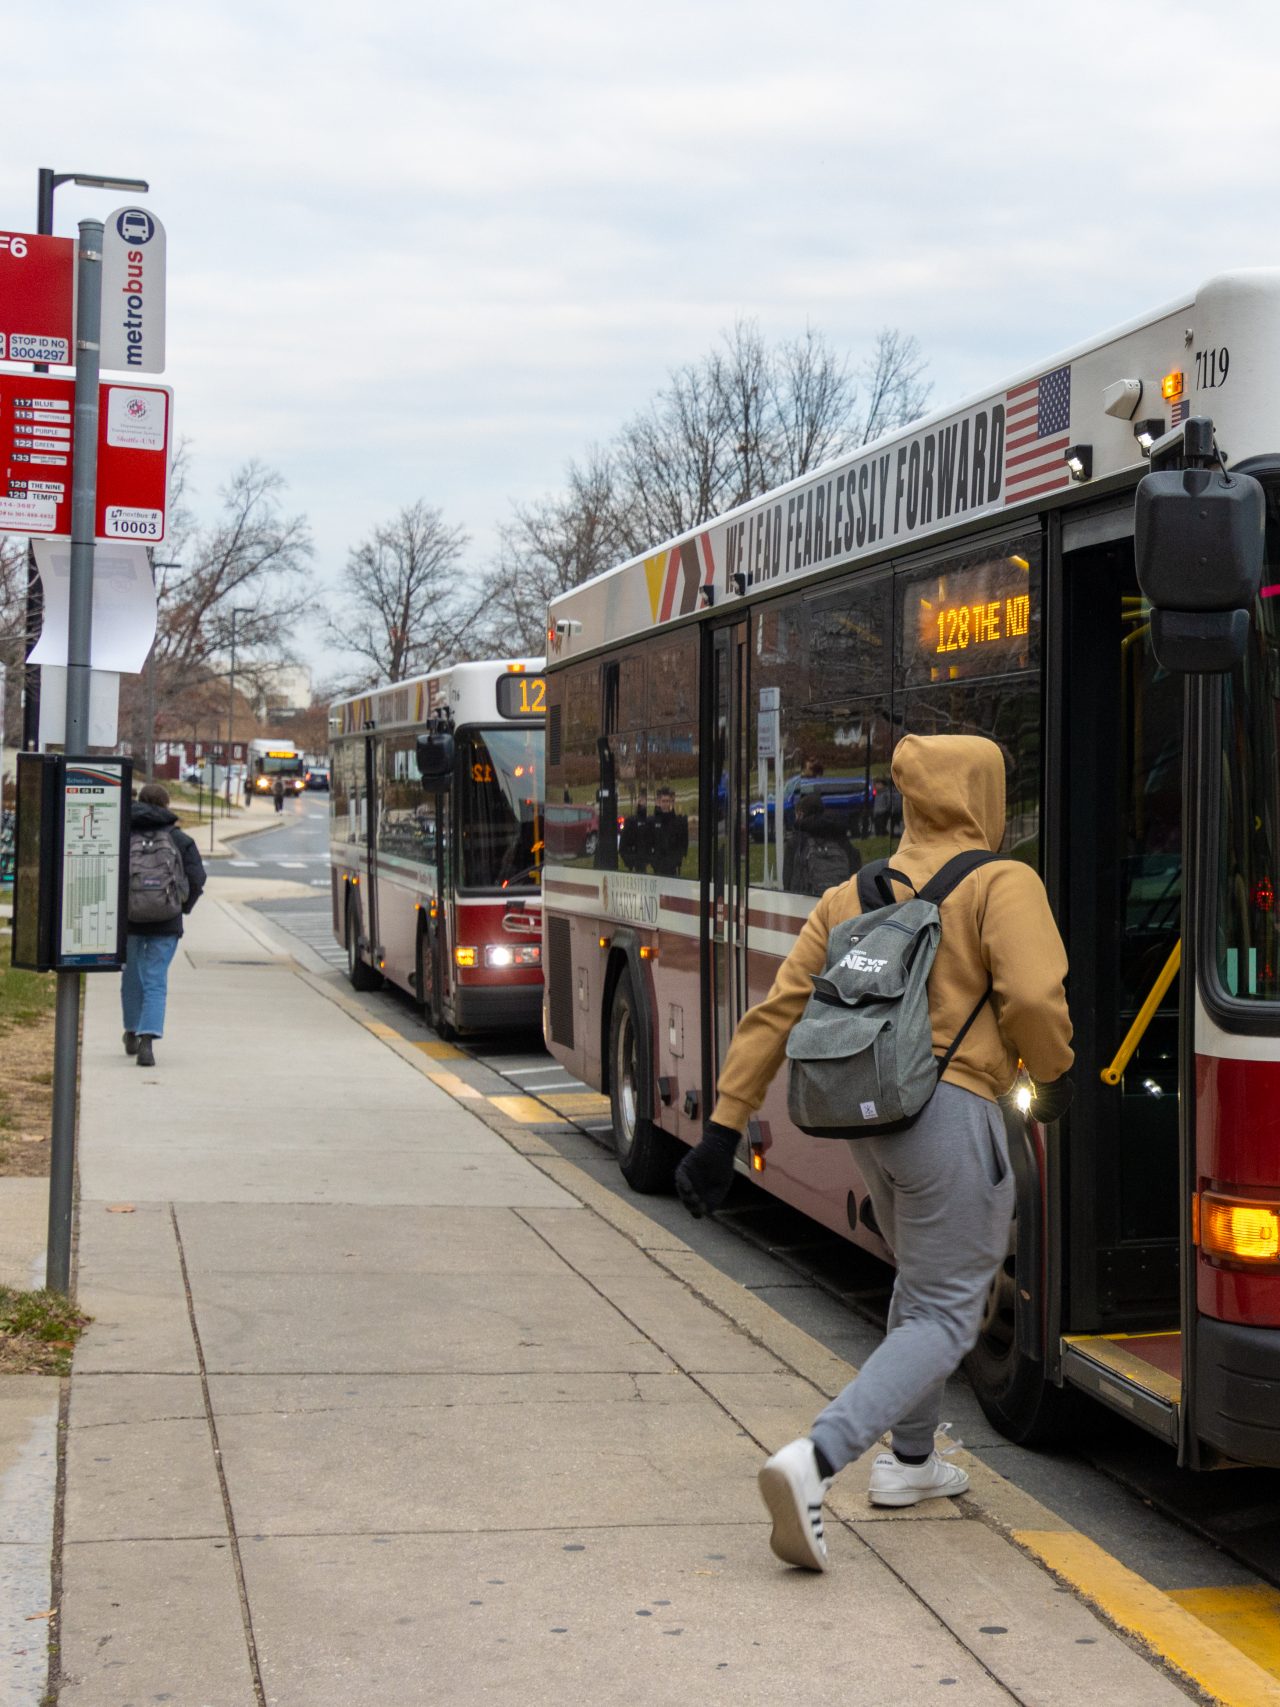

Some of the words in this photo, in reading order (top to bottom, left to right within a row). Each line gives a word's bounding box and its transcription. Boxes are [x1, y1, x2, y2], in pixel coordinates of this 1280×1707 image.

[123, 250, 143, 366] metrobus
[11, 336, 37, 346] STOP
[40, 338, 49, 347] ID
[11, 347, 65, 361] 3004297
[1195, 347, 1229, 391] 7119
[14, 399, 32, 407] 117
[34, 400, 55, 408] BLUE
[15, 410, 33, 419] 113
[35, 428, 59, 436] PURPLE
[15, 439, 32, 448] 122
[34, 441, 55, 449] GREEN
[11, 453, 29, 462] 133
[10, 480, 27, 488] 128
[31, 482, 44, 490] THE
[45, 483, 62, 491] NINE
[8, 490, 26, 499] 129
[747, 505, 782, 587] LEAD
[785, 453, 890, 573] FEARLESSLY
[894, 403, 1005, 535] FORWARD
[112, 520, 156, 535] 10003
[936, 605, 970, 653] 128
[972, 601, 1001, 643] THE
[609, 890, 658, 923] MARYLAND
[840, 954, 888, 973] NEXT
